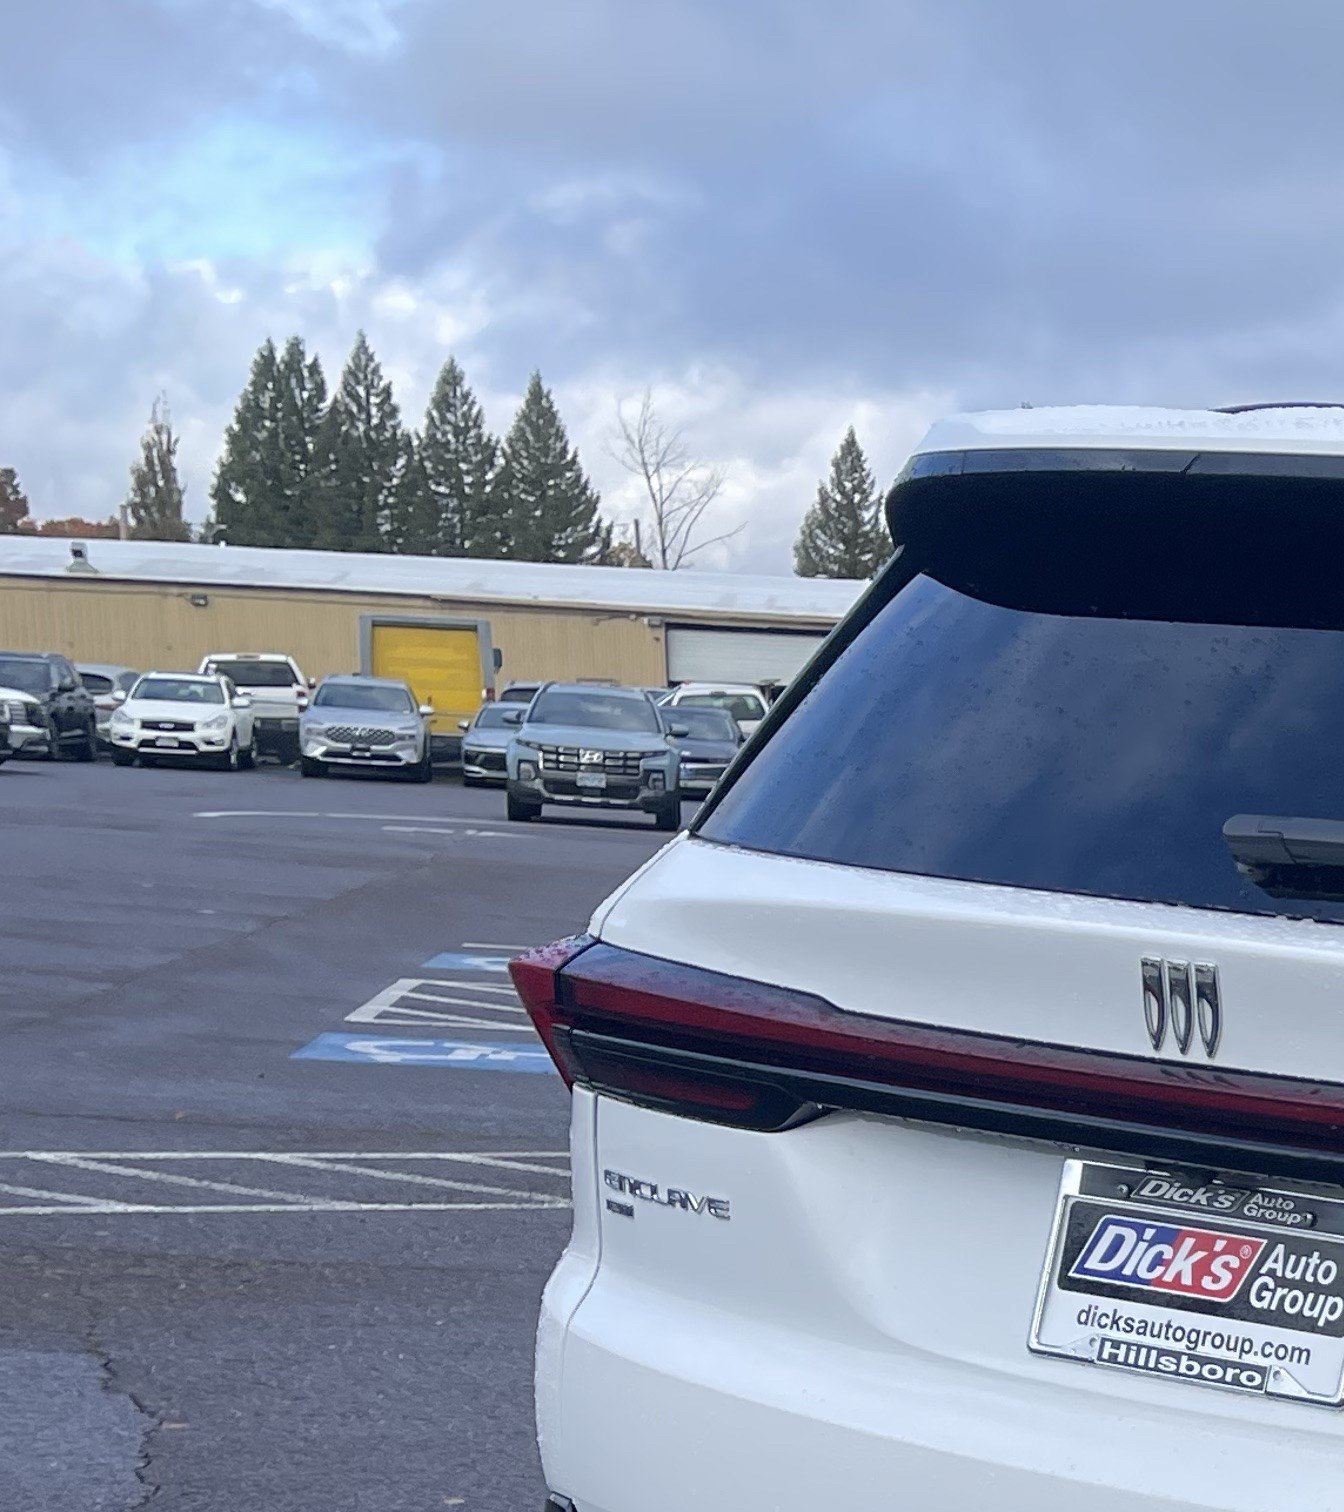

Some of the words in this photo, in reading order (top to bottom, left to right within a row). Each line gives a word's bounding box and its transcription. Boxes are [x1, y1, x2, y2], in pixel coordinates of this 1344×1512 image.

[604, 1169, 731, 1221] ENCLAVE
[1139, 1178, 1236, 1209] Dick's
[1243, 1203, 1301, 1225] Group
[1250, 1192, 1295, 1211] Auto
[1084, 1224, 1240, 1291] Dick's
[1259, 1243, 1338, 1285] Auto
[1249, 1275, 1344, 1327] Group
[1076, 1304, 1311, 1366] dicksautogroup.com
[1100, 1341, 1263, 1387] Hillsboro
